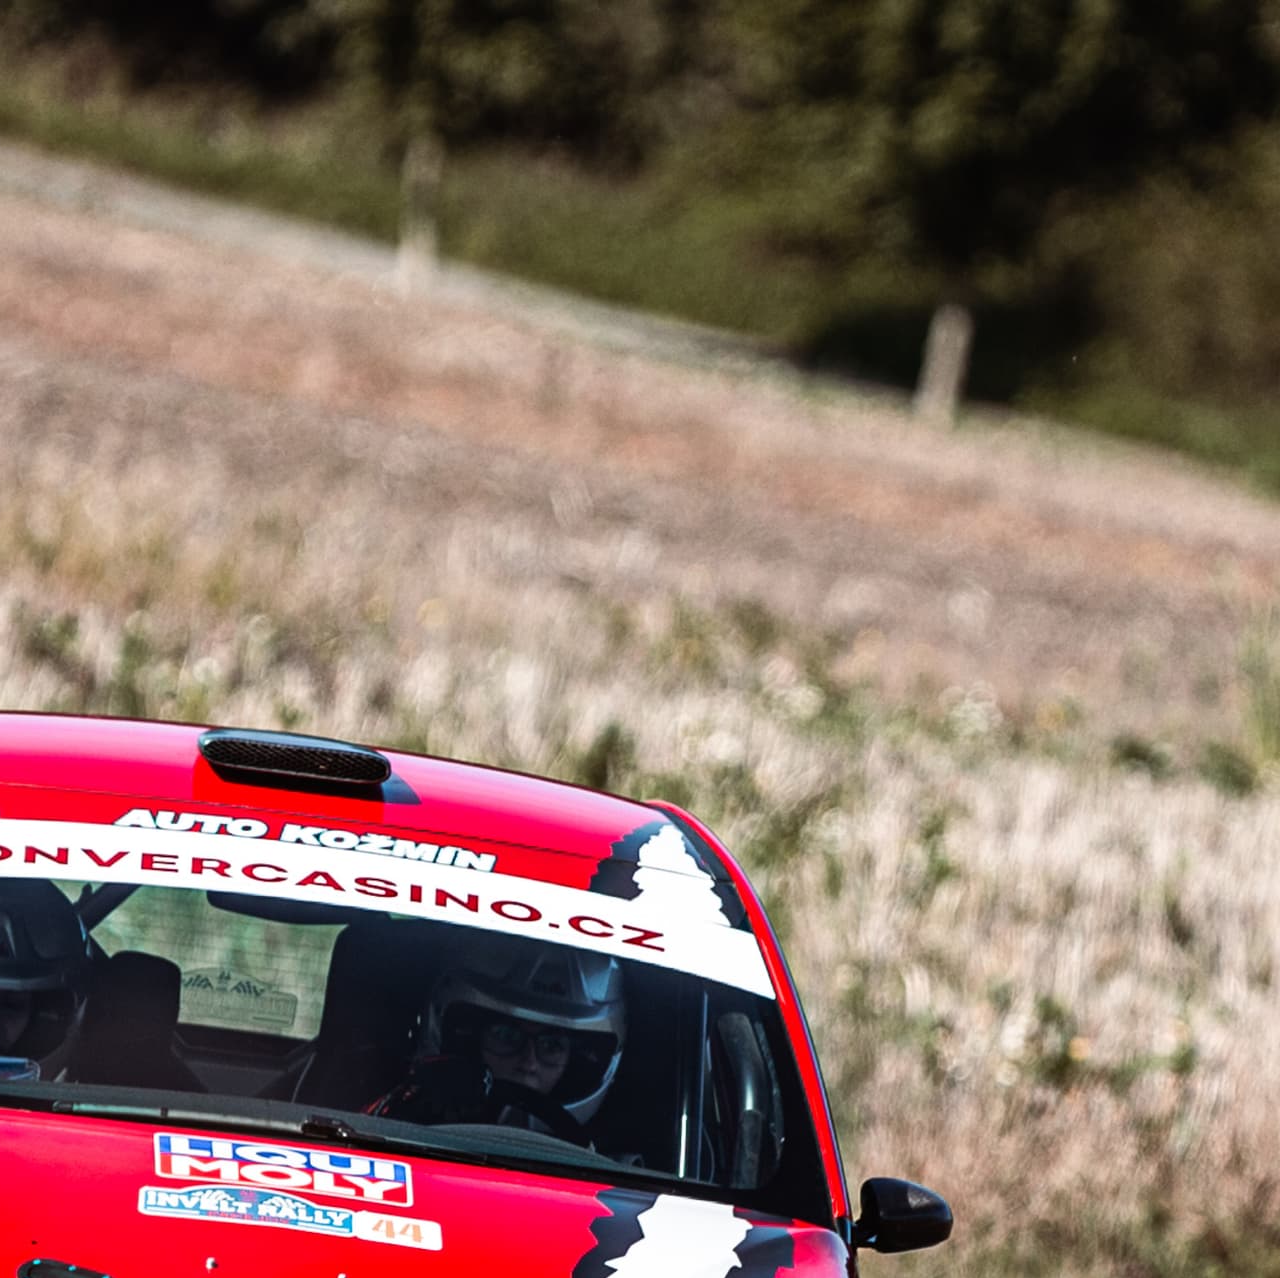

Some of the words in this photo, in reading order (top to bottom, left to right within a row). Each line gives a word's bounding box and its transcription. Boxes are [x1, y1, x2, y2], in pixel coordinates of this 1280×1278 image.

[114, 807, 269, 839] AUTO
[280, 822, 497, 873] KOŽMÍN
[170, 1137, 404, 1181] LIQUI
[170, 1155, 404, 1201] MOLY
[256, 1199, 354, 1226] RALLY
[371, 1217, 425, 1244] 44
